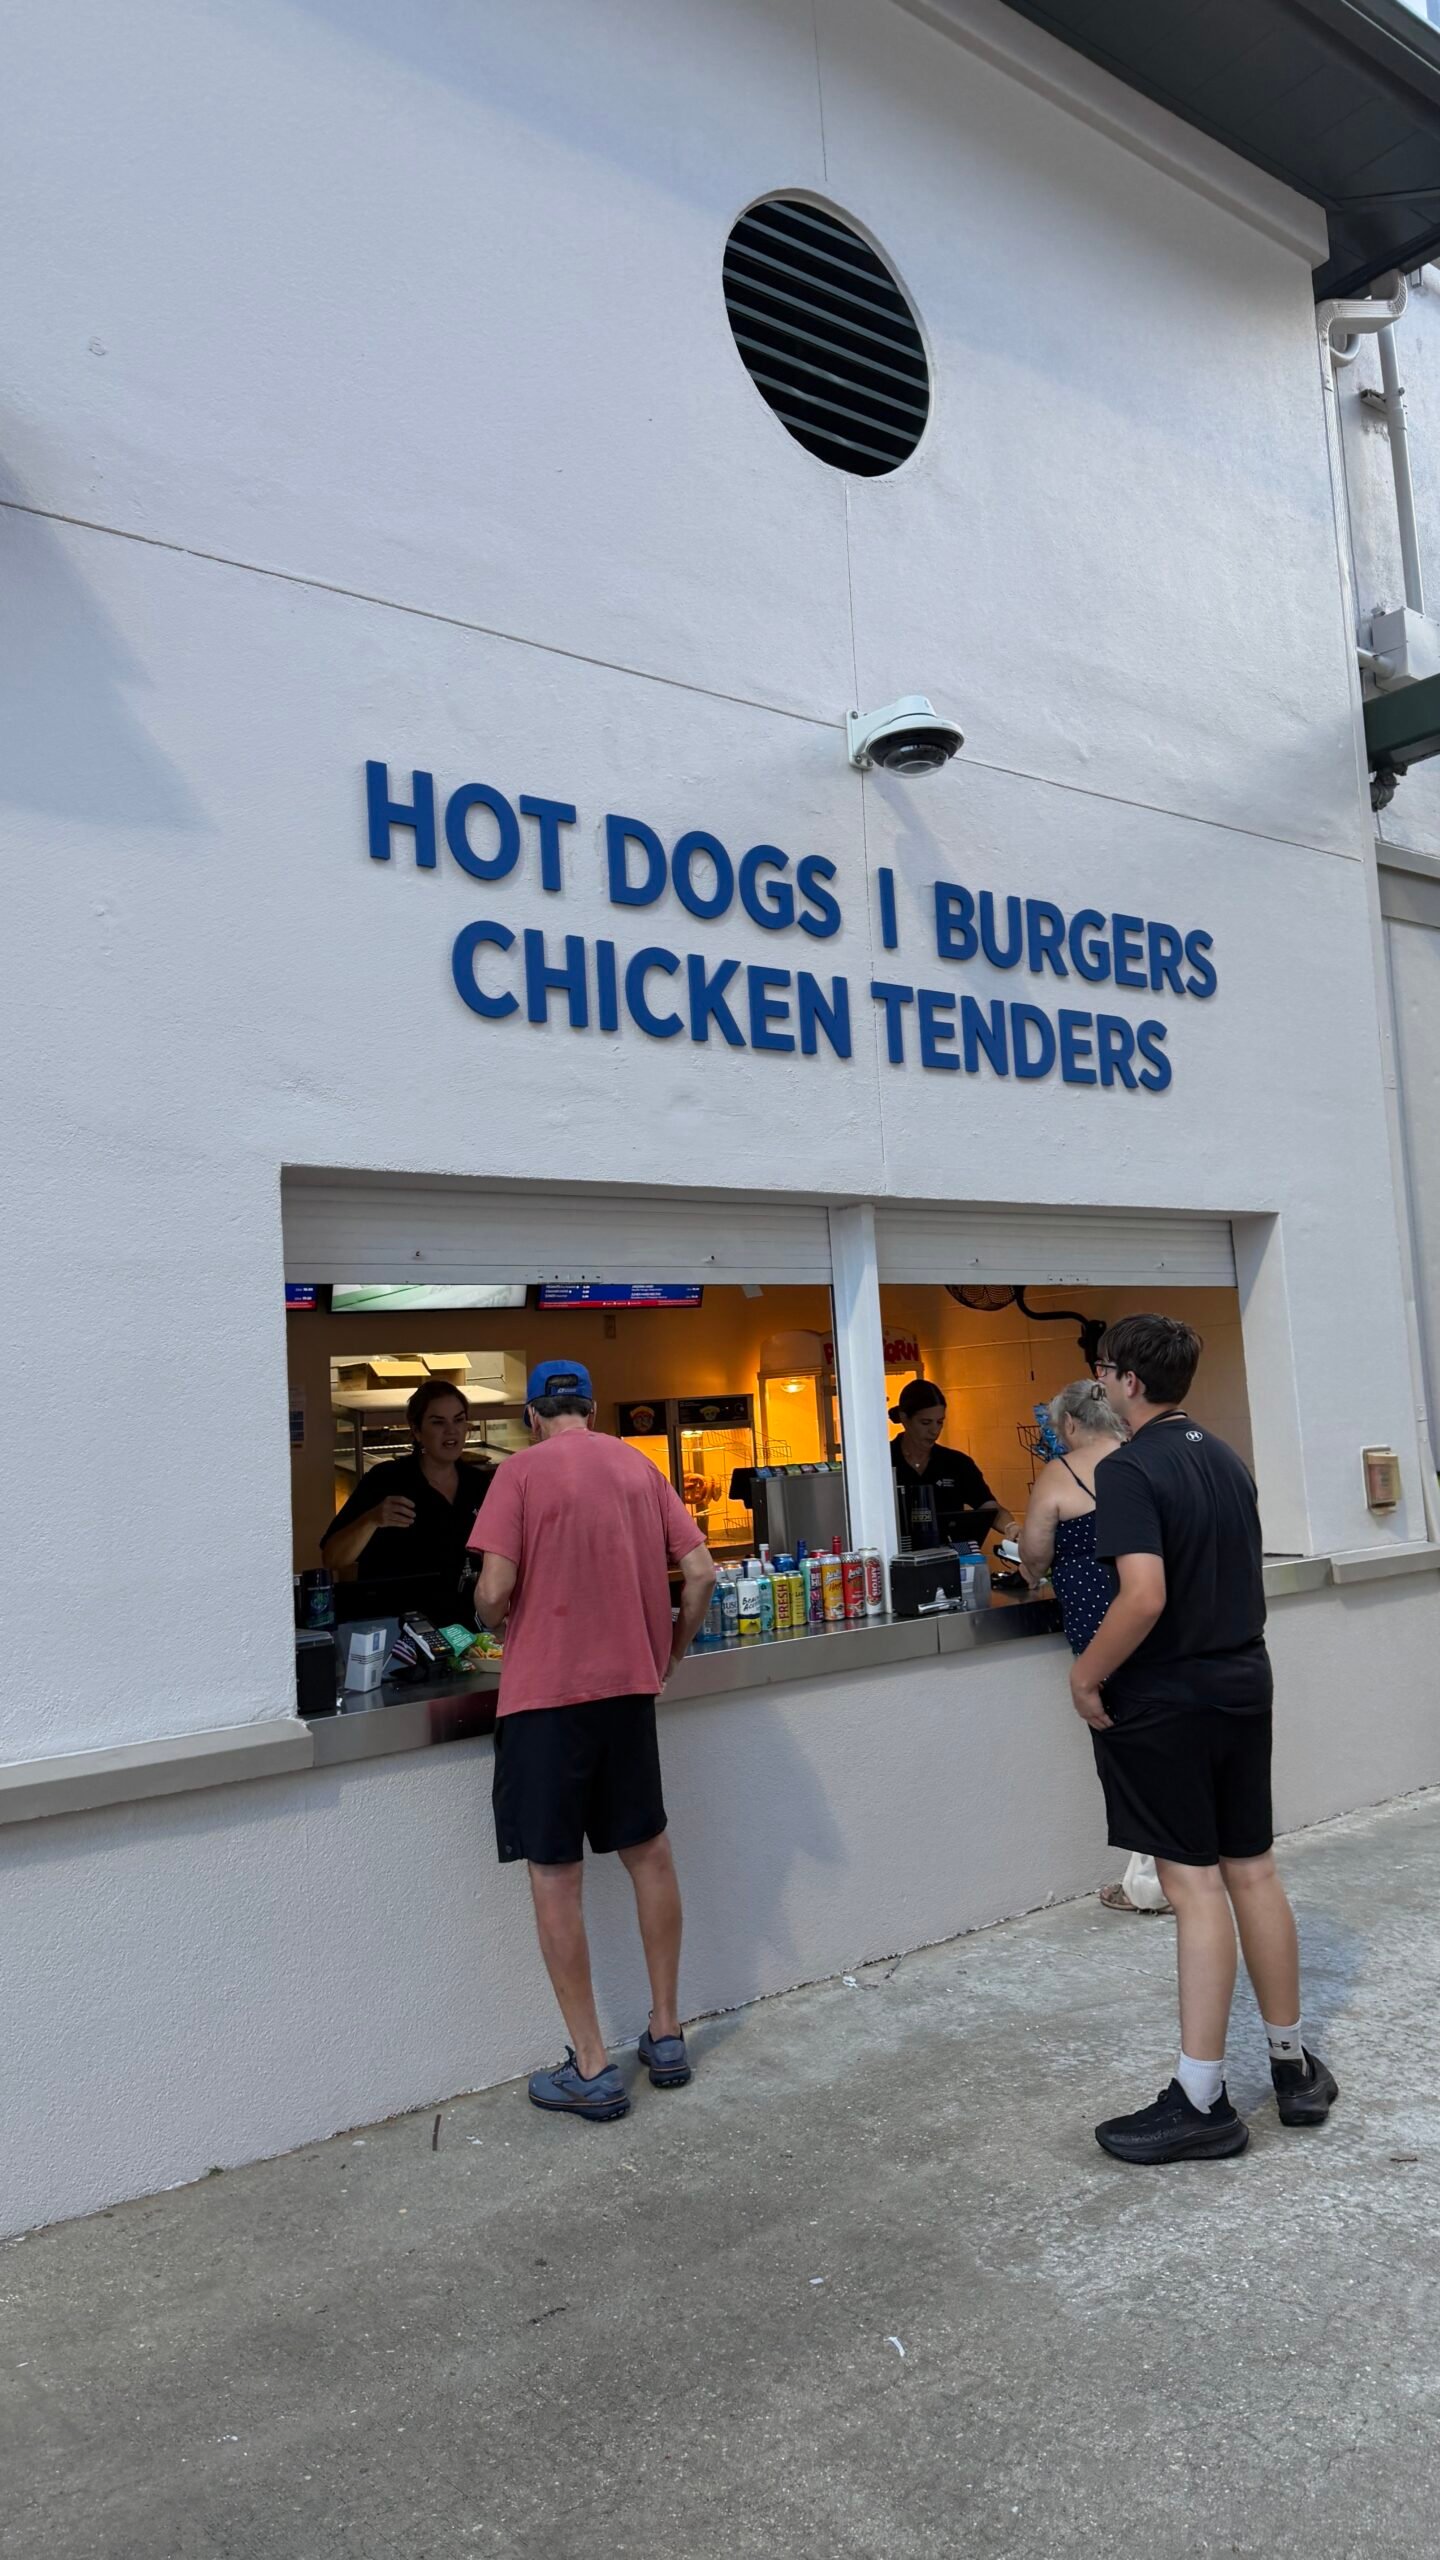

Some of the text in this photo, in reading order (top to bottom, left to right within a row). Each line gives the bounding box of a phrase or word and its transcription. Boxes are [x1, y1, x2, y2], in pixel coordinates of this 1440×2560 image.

[366, 760, 577, 891] HOT
[606, 813, 841, 938] DOGS
[934, 881, 1218, 998] BURGERS
[451, 919, 1172, 1091] CHICKEN TENDERS
[823, 1336, 919, 1365] PORN
[777, 1583, 790, 1619] FRESH
